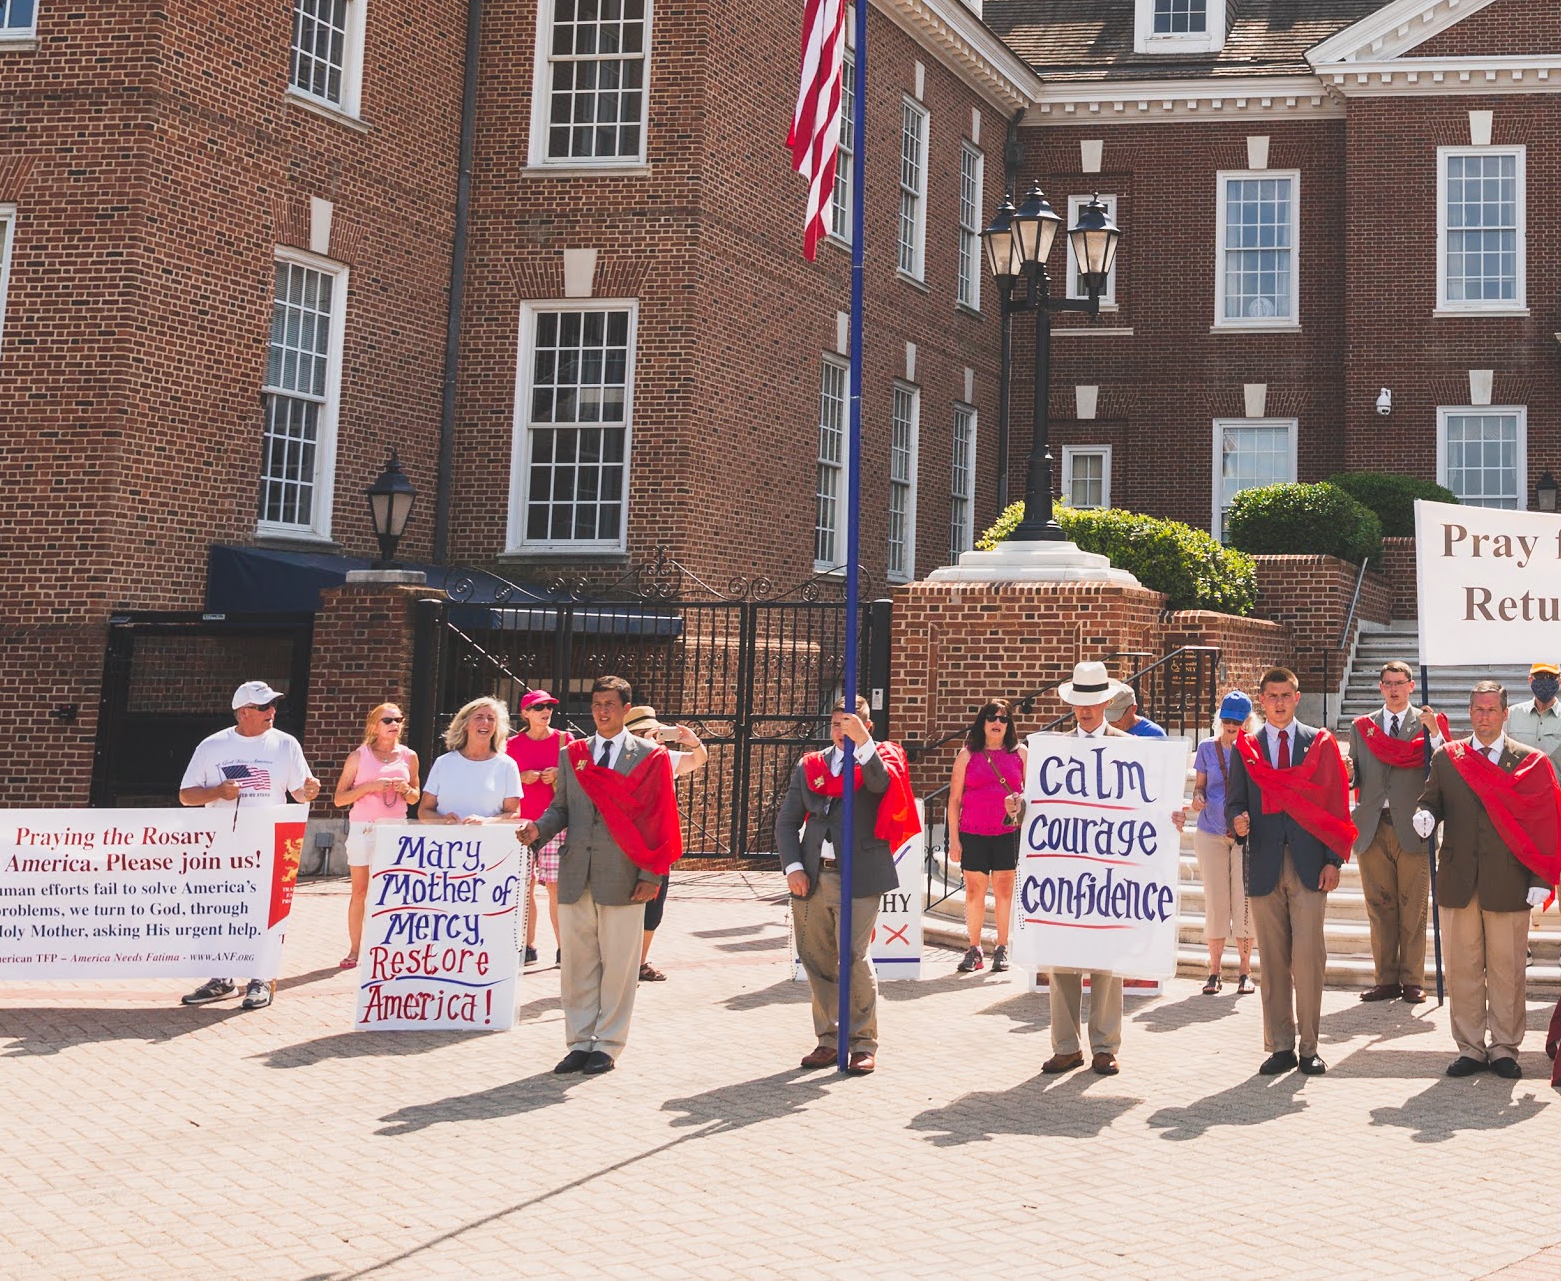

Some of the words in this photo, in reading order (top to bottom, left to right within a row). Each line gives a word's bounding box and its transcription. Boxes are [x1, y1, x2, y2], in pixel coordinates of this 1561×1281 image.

[1440, 524, 1539, 568] Pray
[16, 827, 95, 850] Praying
[103, 827, 134, 846] the
[142, 826, 217, 848] Rosary
[1028, 814, 1157, 856] courage
[5, 854, 99, 872] America.
[107, 853, 174, 871] Please
[179, 851, 222, 874] join
[229, 850, 262, 870] us!
[391, 836, 486, 871] Mary,
[41, 883, 89, 896] efforts
[94, 882, 118, 895] fail
[123, 884, 137, 895] to
[141, 882, 178, 895] solve
[182, 880, 257, 895] America's
[375, 871, 486, 906] Mother
[492, 875, 518, 906] of
[1021, 868, 1173, 922] confidence
[69, 906, 89, 917] we
[94, 904, 126, 916] turn
[131, 904, 145, 915] to
[150, 902, 186, 917] God,
[191, 901, 249, 919] through
[30, 924, 89, 939] Mother,
[93, 923, 141, 939] asking
[146, 922, 170, 937] His
[175, 924, 223, 938] urgent
[228, 922, 261, 938] help.
[381, 913, 485, 946] Mercy,
[36, 953, 57, 963] TFP
[70, 953, 110, 963] America
[114, 953, 142, 962] Needs
[146, 953, 179, 962] Fatima
[370, 944, 489, 981] Restore
